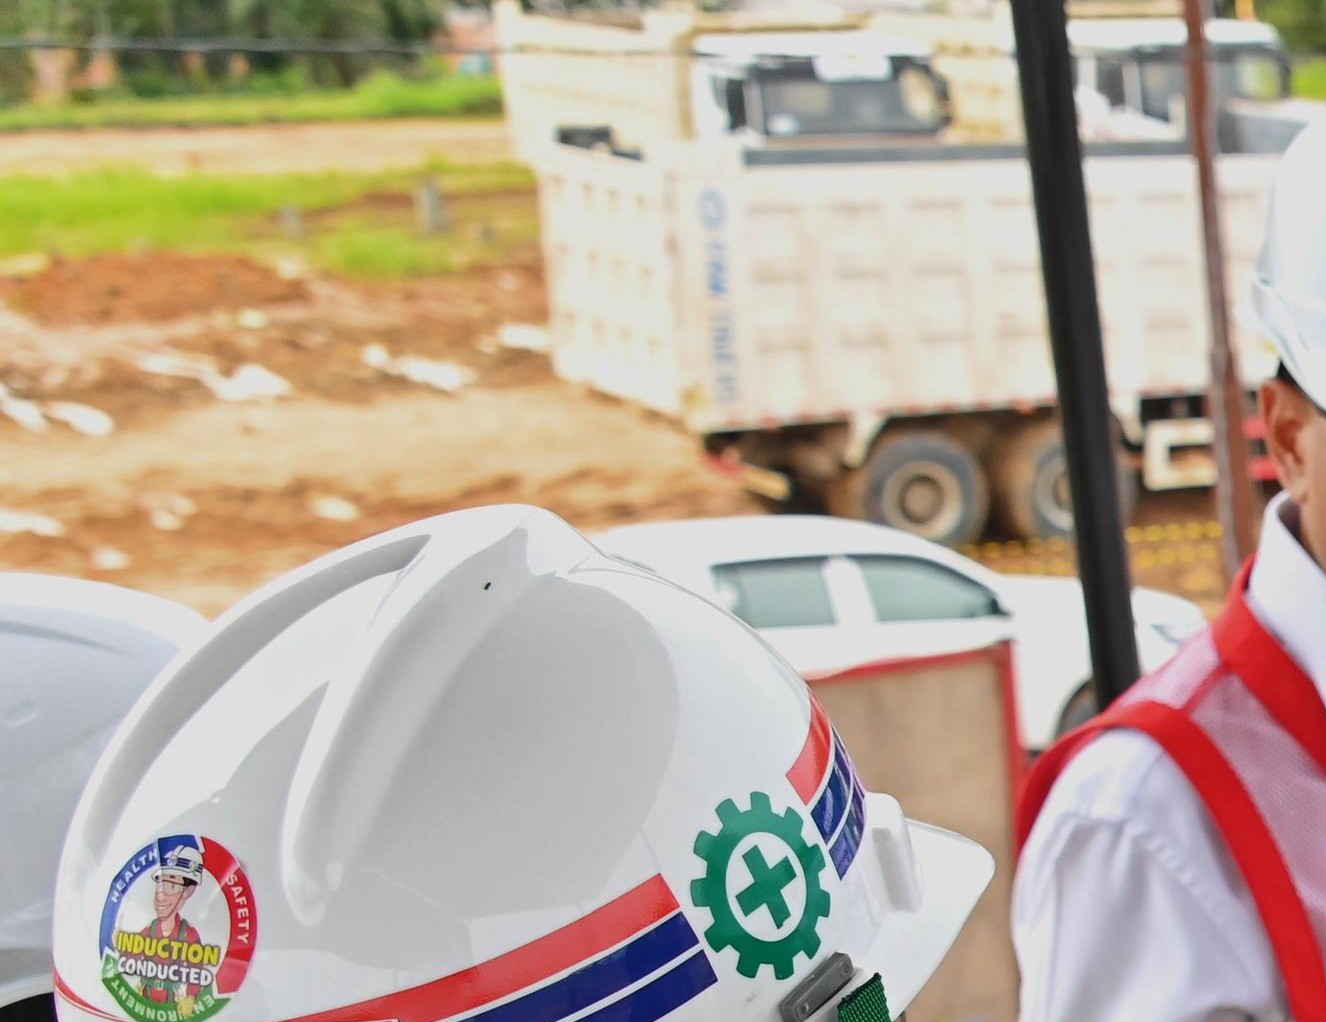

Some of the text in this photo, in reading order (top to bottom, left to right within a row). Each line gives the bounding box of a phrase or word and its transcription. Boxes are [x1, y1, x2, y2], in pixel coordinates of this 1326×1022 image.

[112, 848, 159, 903] HEALTH
[226, 874, 250, 944] SAFETY
[116, 931, 221, 966] INDUCTION
[117, 956, 214, 986] CONDUCTED
[110, 979, 215, 1022] ENIRONMENT
